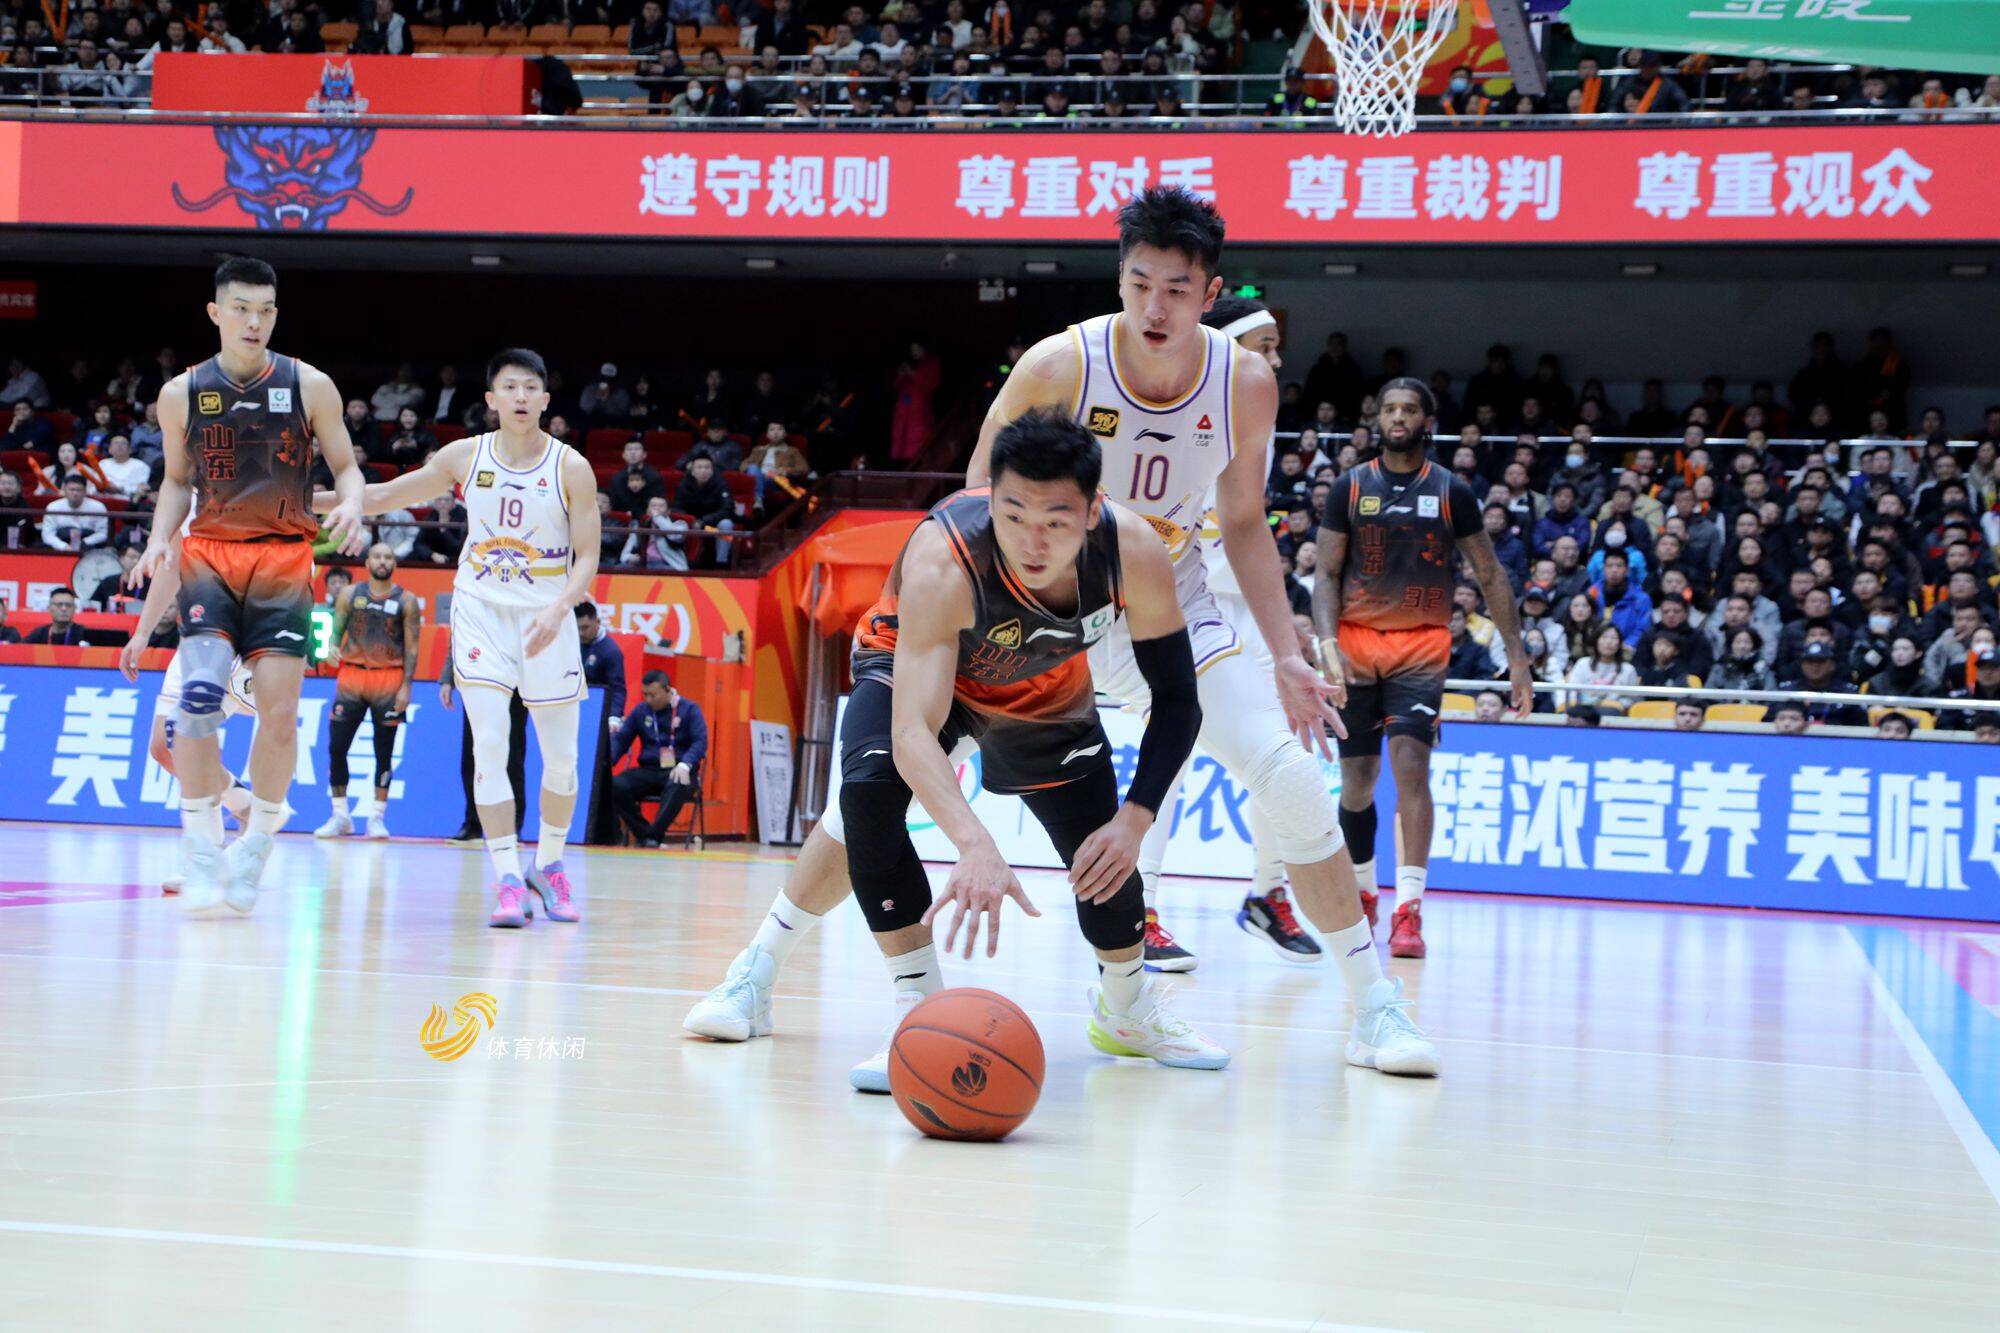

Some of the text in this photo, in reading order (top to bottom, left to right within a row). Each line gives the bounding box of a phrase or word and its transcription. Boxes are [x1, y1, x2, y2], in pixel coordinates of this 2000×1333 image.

[639, 153, 889, 218] 遵守规则
[1284, 153, 1562, 220] 尊重裁判
[1634, 148, 1932, 219] 尊重观众
[1128, 453, 1170, 502] 10
[498, 496, 524, 529] 19
[311, 611, 335, 660] 3
[1428, 752, 1766, 878] 臻浓营养
